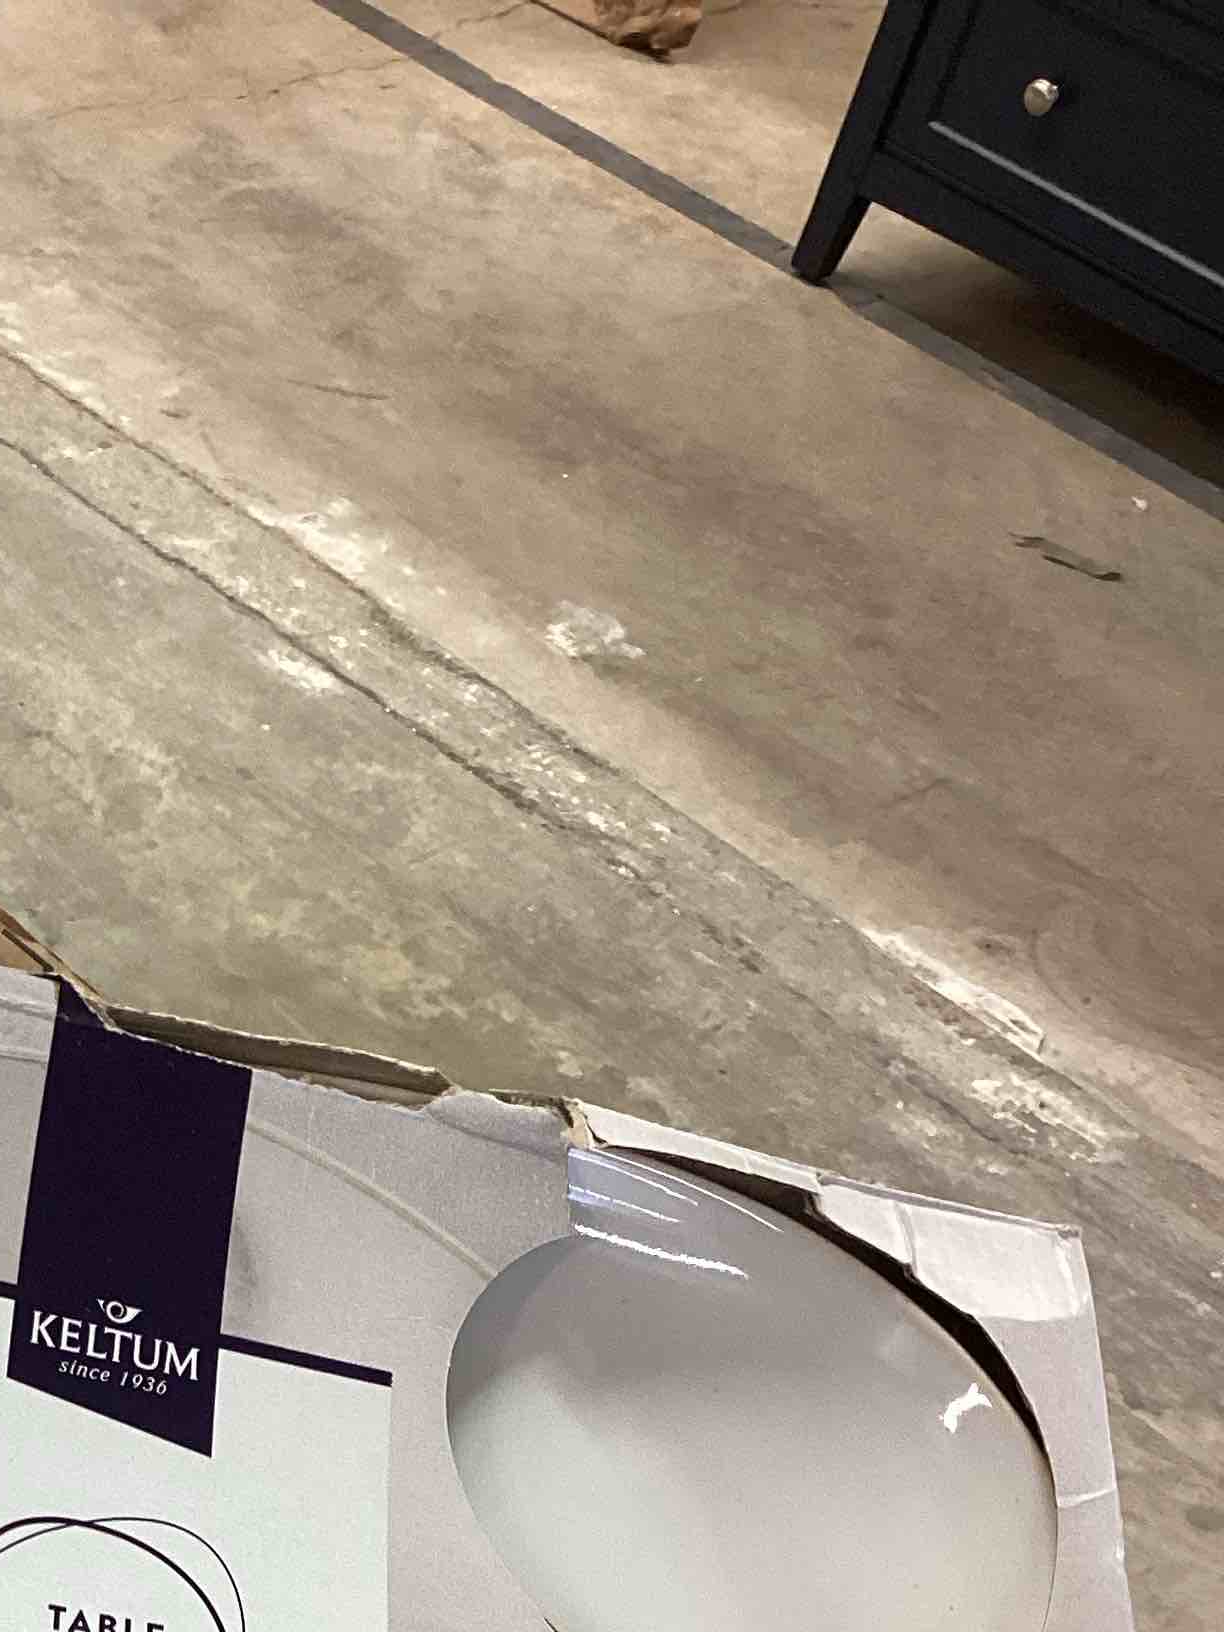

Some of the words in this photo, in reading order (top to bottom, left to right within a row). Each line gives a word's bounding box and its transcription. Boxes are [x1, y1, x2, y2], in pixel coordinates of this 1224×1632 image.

[30, 1310, 200, 1381] KELTUM
[58, 1360, 111, 1382] since
[120, 1371, 168, 1395] 1936
